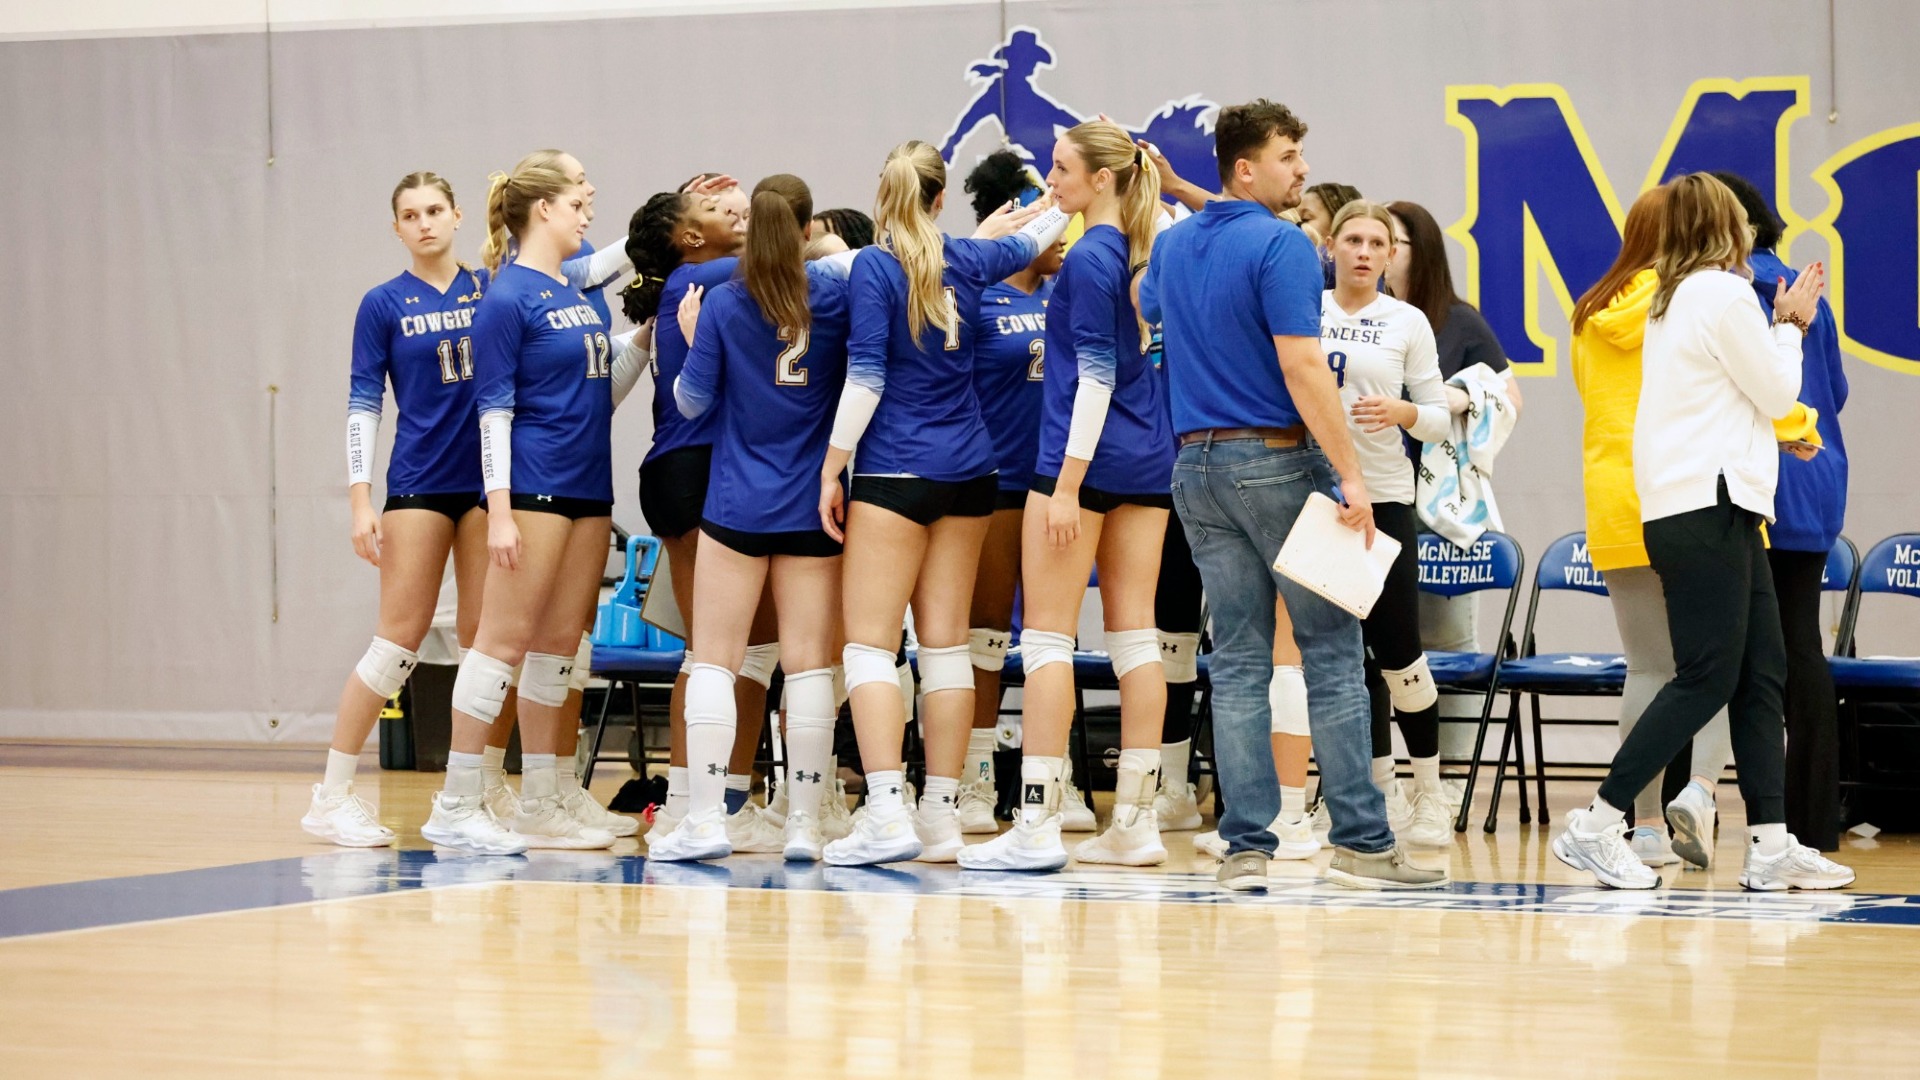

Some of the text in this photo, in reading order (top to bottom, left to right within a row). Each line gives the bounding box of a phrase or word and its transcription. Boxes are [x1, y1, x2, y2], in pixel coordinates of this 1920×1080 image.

[400, 306, 476, 338] COWGIR
[436, 335, 474, 384] 11
[584, 331, 610, 378] 12
[775, 323, 810, 386] 2
[351, 449, 363, 474] POKES
[483, 453, 495, 480] POKES
